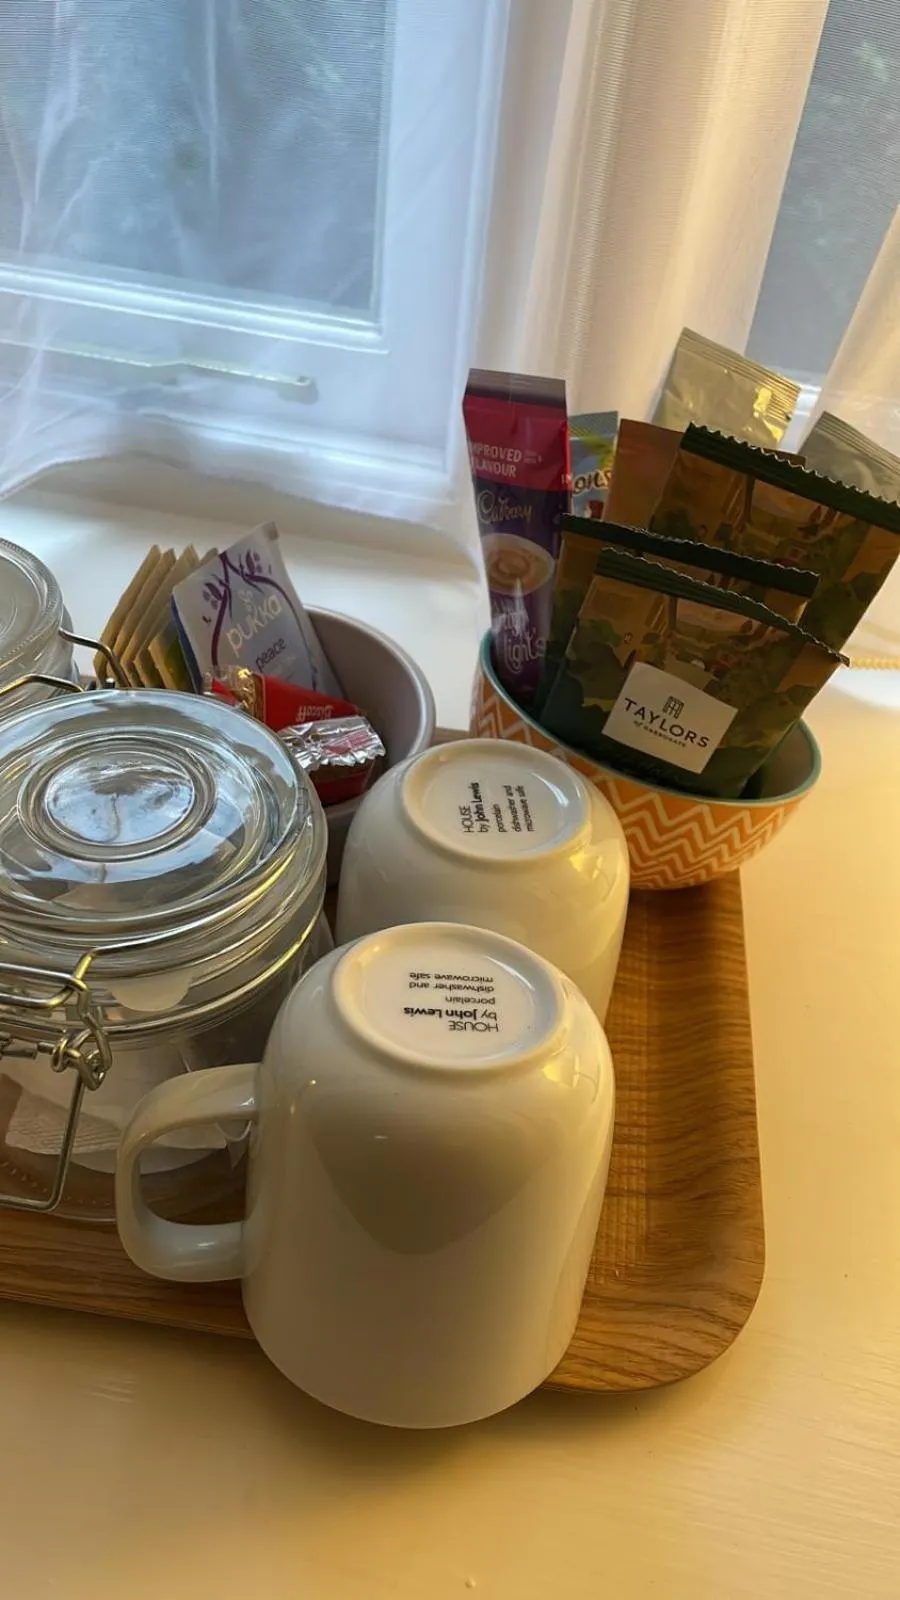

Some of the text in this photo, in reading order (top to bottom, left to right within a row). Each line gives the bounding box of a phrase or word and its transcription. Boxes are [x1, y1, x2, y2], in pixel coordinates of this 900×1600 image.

[226, 594, 283, 660] pukka
[255, 637, 287, 674] peace
[623, 697, 710, 749] TAYLORS
[458, 805, 475, 833] HOUSE
[468, 782, 491, 833] by John Lewis
[492, 803, 508, 833] porcelain
[502, 784, 522, 833] dishwasher and
[515, 784, 536, 832] microwave safe
[408, 972, 494, 984] microwave safe
[408, 981, 495, 993] dishwasher and
[403, 1006, 498, 1021] by John Lewis
[445, 996, 496, 1005] porcelain
[447, 1020, 499, 1032] HOUSE
